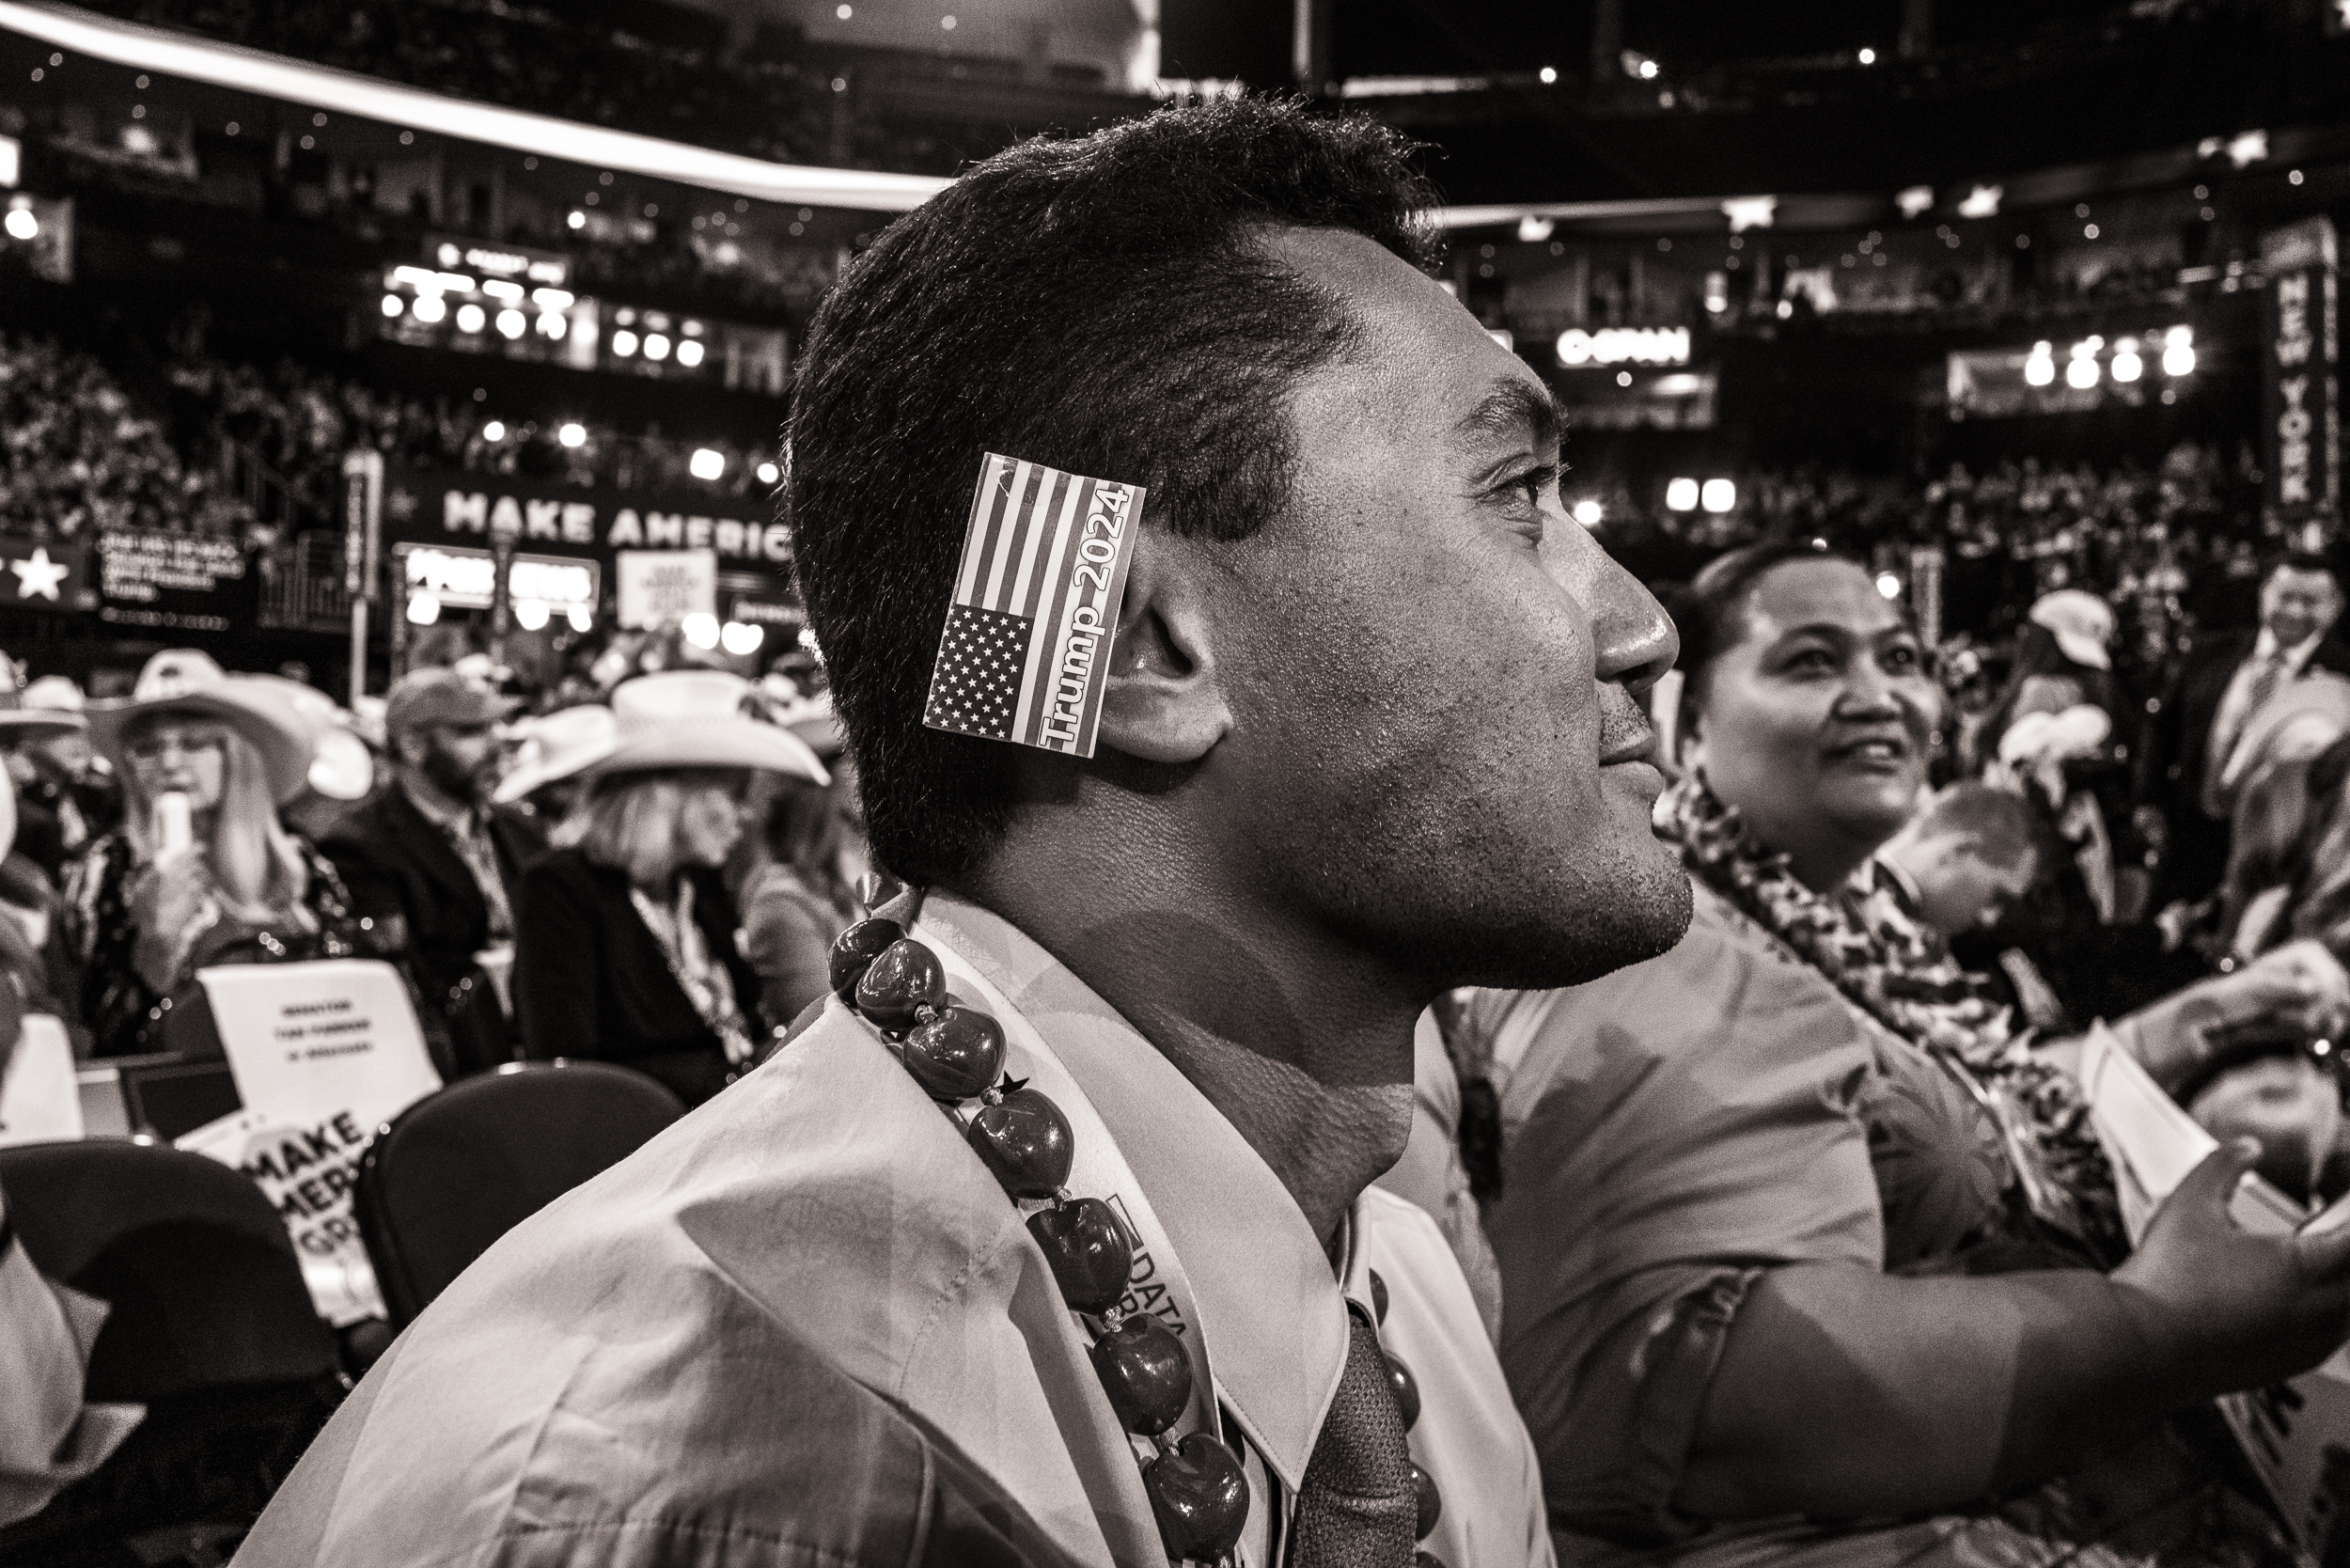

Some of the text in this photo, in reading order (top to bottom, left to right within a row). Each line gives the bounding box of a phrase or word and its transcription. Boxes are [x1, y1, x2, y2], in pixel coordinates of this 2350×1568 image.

[444, 490, 596, 543] MAKE
[1039, 487, 1129, 746] Trump 2024
